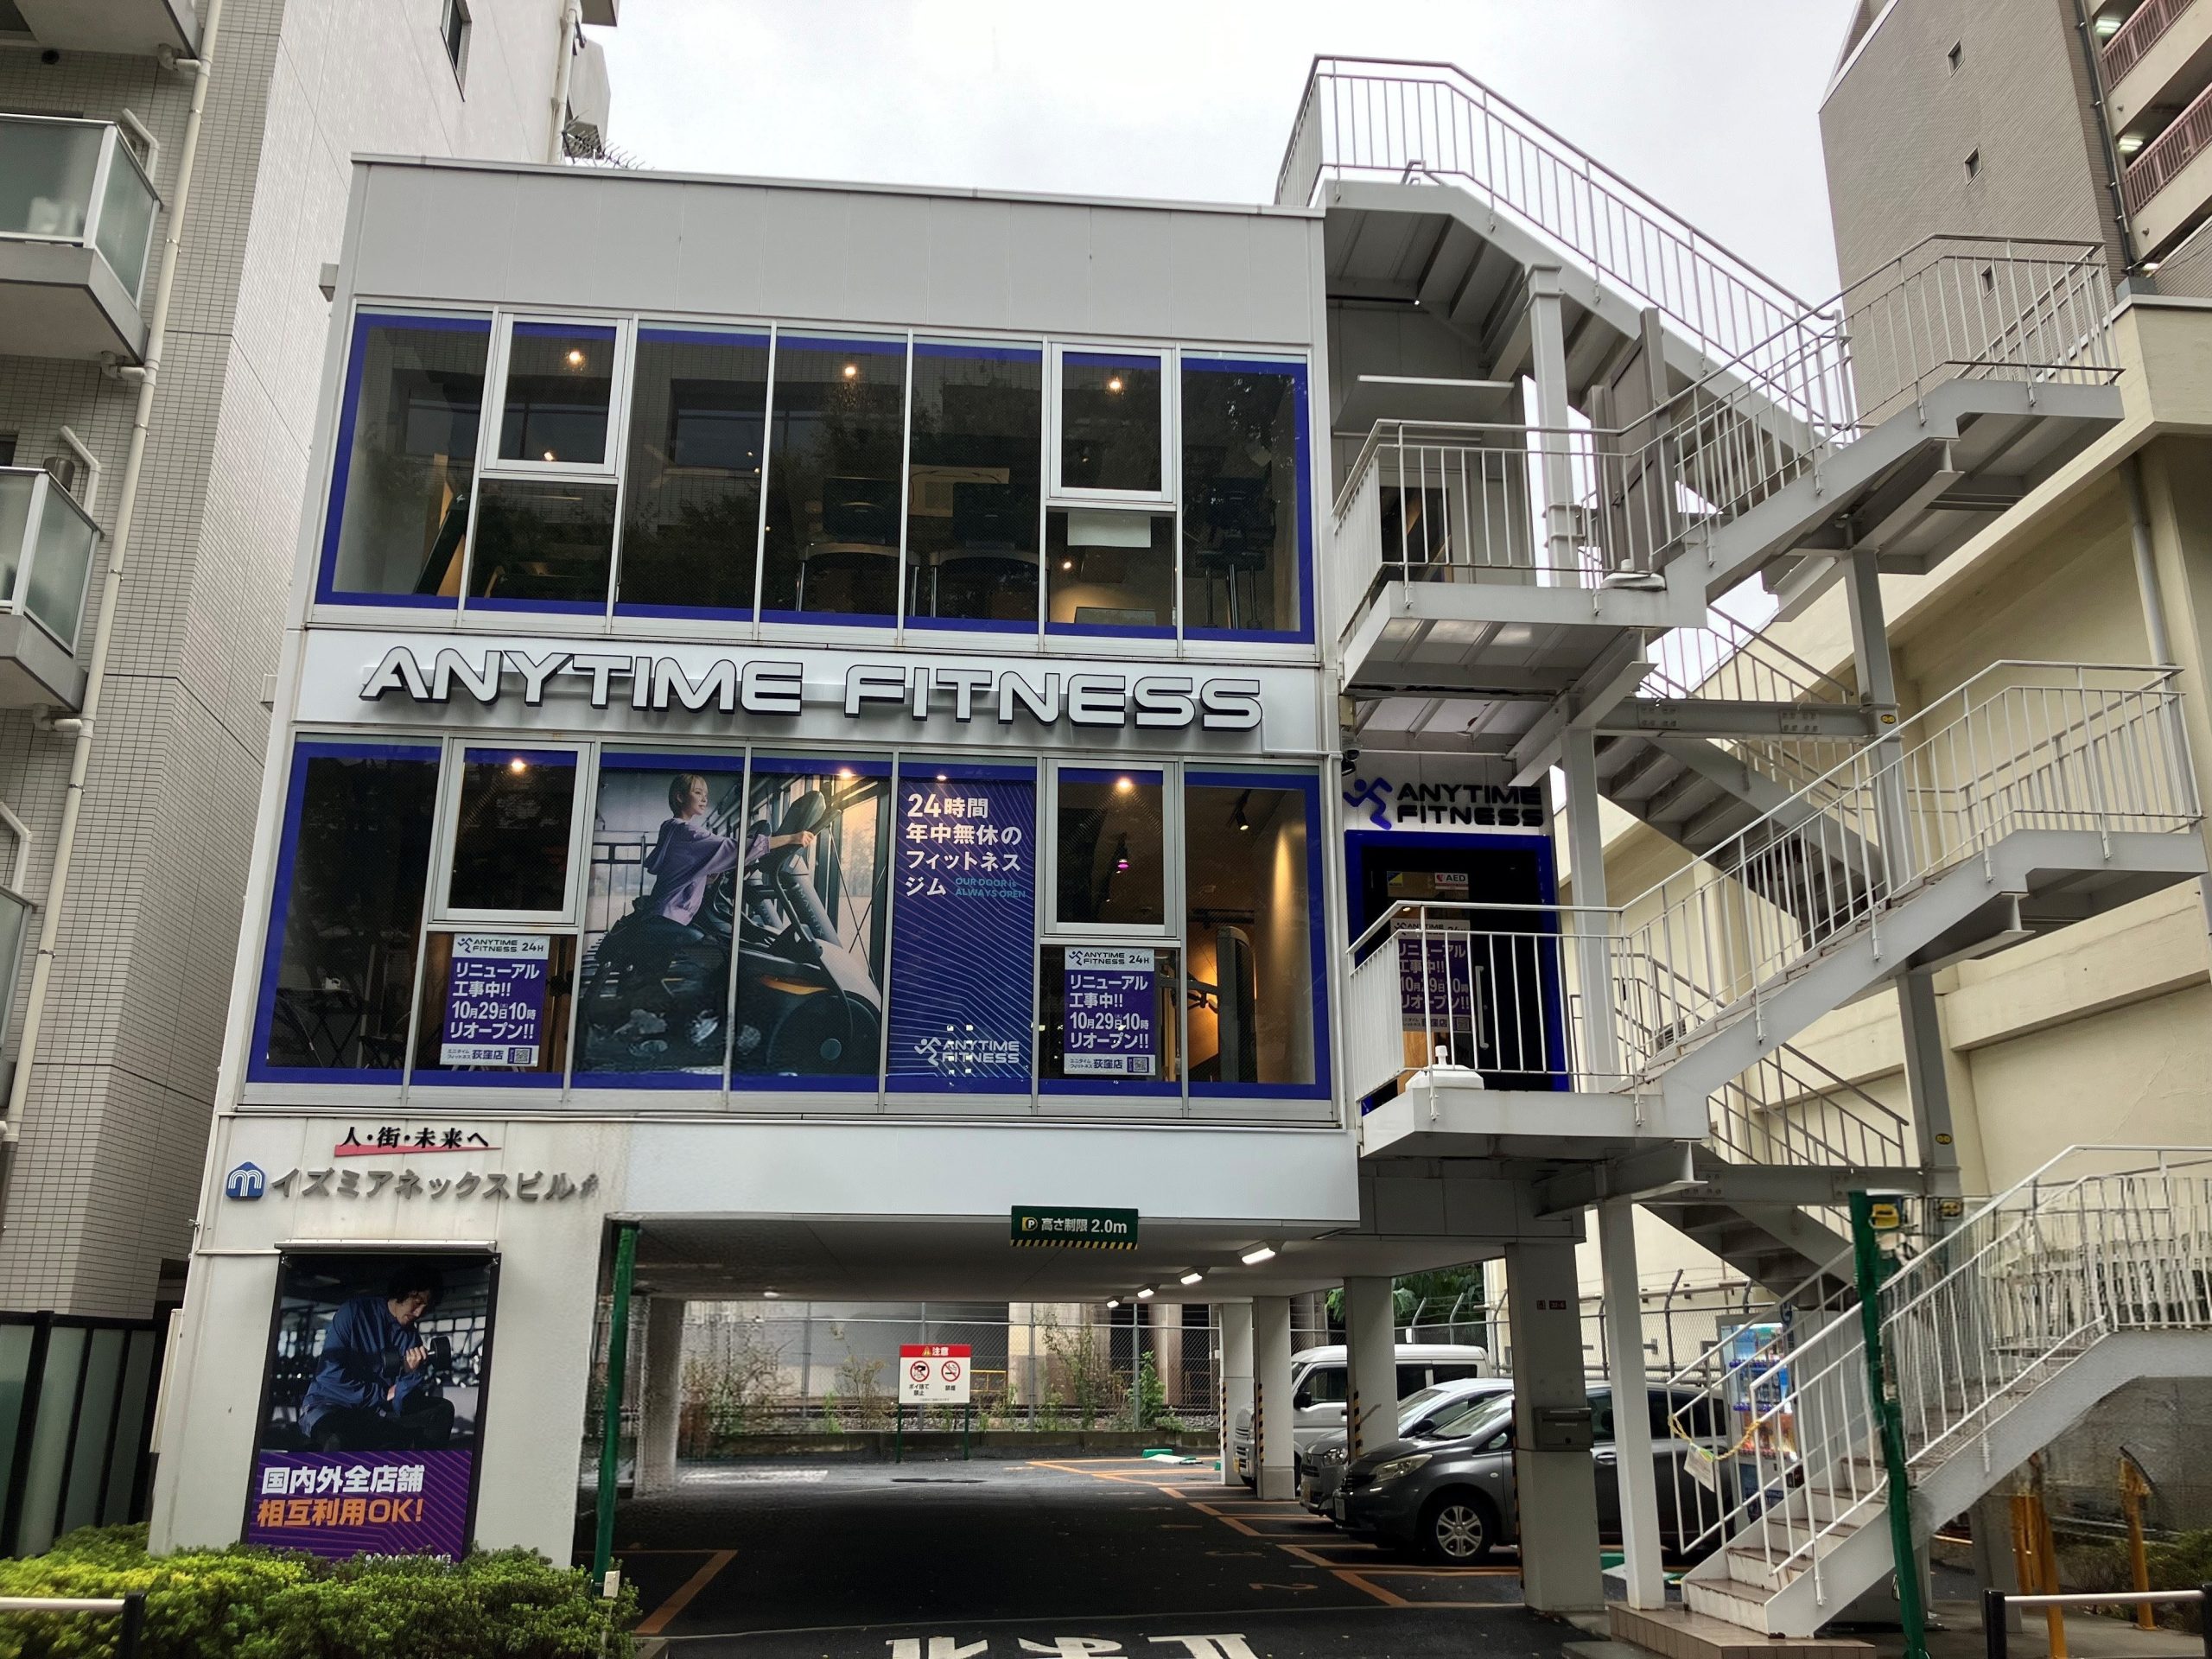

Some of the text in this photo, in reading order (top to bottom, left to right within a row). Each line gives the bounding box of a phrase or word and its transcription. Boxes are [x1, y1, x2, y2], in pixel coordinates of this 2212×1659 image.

[359, 645, 1263, 731] ANYTIME FITNESS
[1397, 782, 1541, 805] ANYTIME
[907, 793, 988, 819] 24時間
[1397, 805, 1544, 827] FITNESS
[906, 823, 1022, 846] 年中無休の
[906, 850, 1021, 872] フィットネス
[906, 876, 947, 896] ジム
[955, 877, 976, 886] OUR
[978, 878, 1007, 887] DOOR
[955, 889, 1027, 899] ALWAYS OPEN
[522, 943, 543, 952] 24H
[1128, 956, 1149, 964] 24H
[456, 963, 540, 979] リニューアル
[453, 981, 511, 998] 工事中!!
[1070, 975, 1148, 990] リニューアル
[1069, 992, 1123, 1008] 工事中!!
[450, 1021, 535, 1039] リオープン!!
[943, 1040, 1020, 1052] ANYTIME
[1071, 1033, 1148, 1049] リオープン!!
[942, 1052, 1020, 1064] FITNESS
[1041, 1217, 1088, 1232] 高さ制限
[1090, 1219, 1128, 1234] 2.0m
[932, 1346, 950, 1356] 注意
[261, 1465, 425, 1494] 国内外全店舗
[257, 1498, 424, 1528] 相互利用OK!
